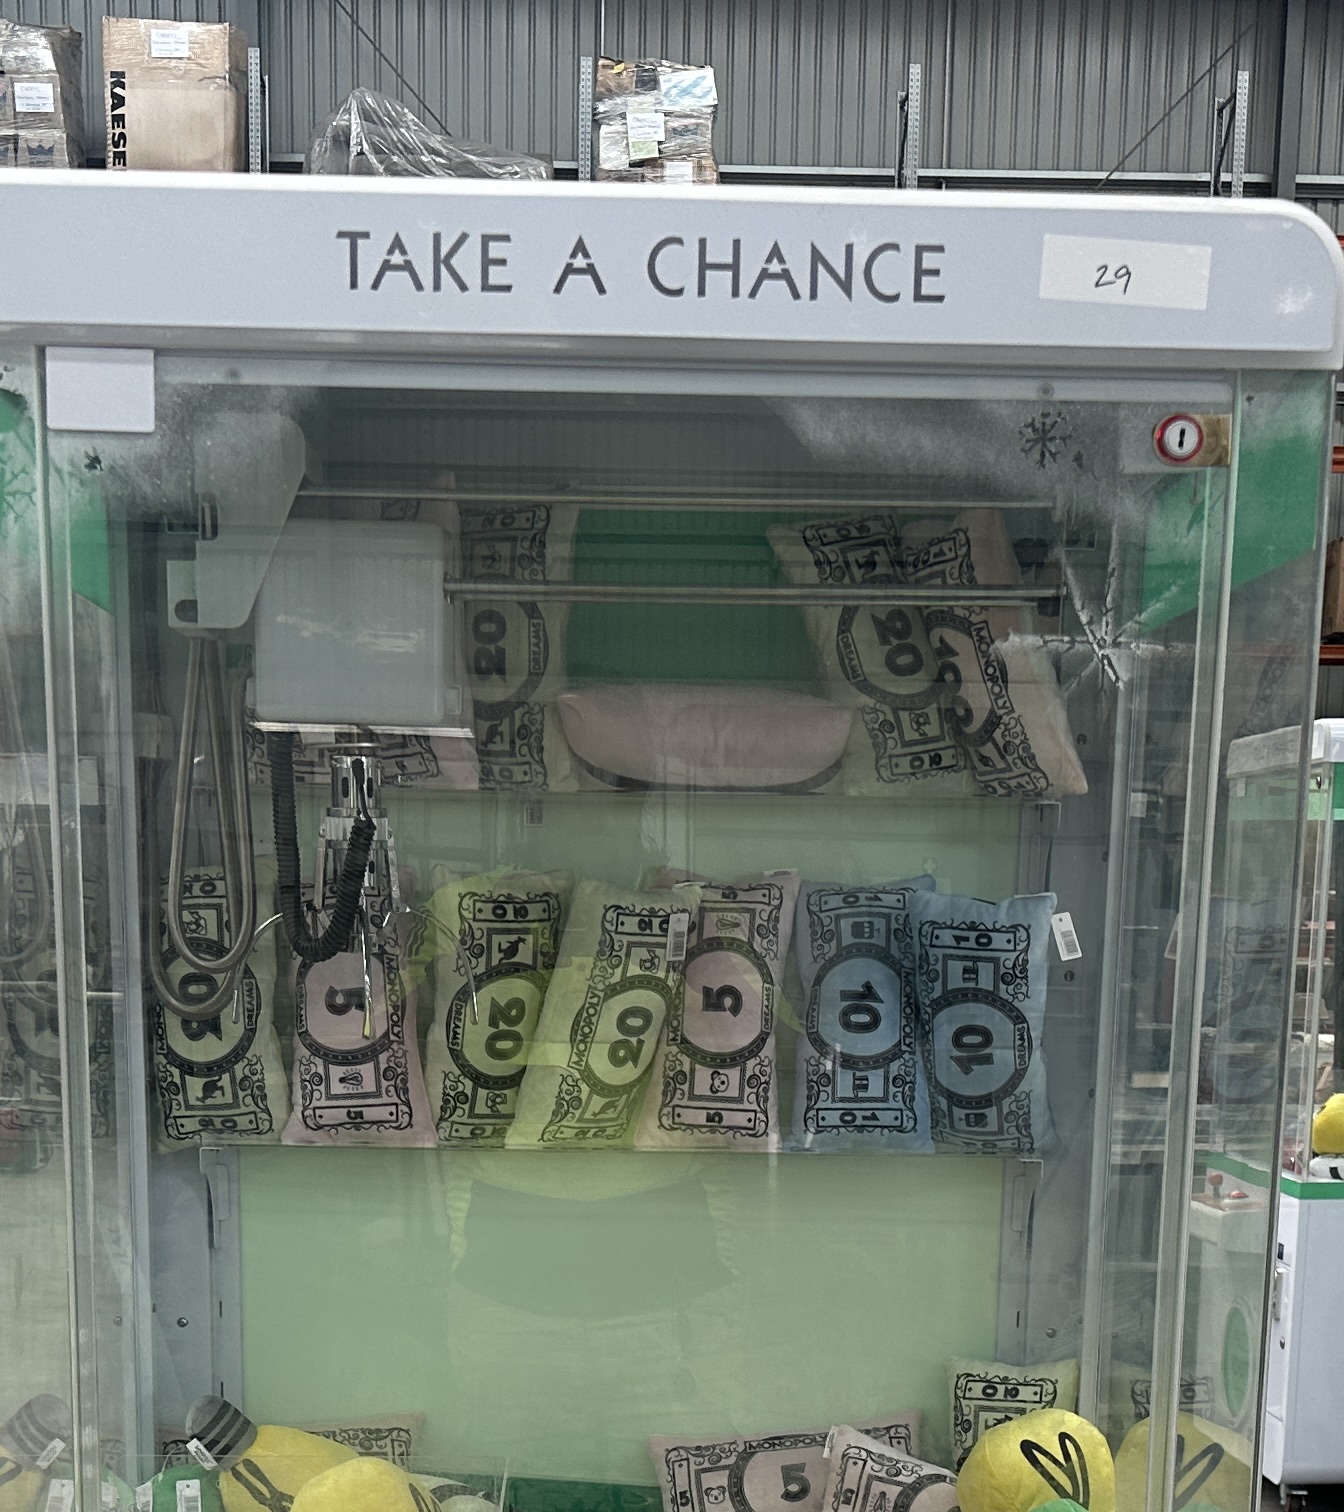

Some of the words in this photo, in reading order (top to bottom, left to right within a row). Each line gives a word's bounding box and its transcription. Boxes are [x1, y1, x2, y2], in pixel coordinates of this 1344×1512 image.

[110, 71, 127, 170] KAESE
[335, 230, 513, 293] TAKE
[552, 236, 607, 296] A
[646, 235, 946, 304] CHANCE
[1093, 263, 1132, 295] 29
[472, 609, 507, 683] 20
[530, 620, 542, 672] DREAMS
[840, 635, 863, 680] DREAMS
[870, 608, 924, 677] 20
[935, 634, 974, 728] 100
[973, 625, 1011, 711] MONOPOLY
[952, 933, 994, 948] 10
[245, 980, 255, 1028] DREAMS
[386, 956, 402, 1040] MONOPOLY
[702, 984, 744, 1018] 5
[762, 986, 773, 1031] DREAMS
[839, 980, 885, 1035] 10
[901, 969, 915, 1050] MONOPOLY
[451, 1003, 464, 1049] DREAMS
[485, 996, 527, 1062] 20
[571, 991, 603, 1069] MONOPOLY
[607, 1005, 654, 1069] 20
[949, 1024, 995, 1076] 10
[1017, 1025, 1029, 1068] DREAMS
[346, 1108, 365, 1121] 5
[706, 1110, 724, 1125] 5
[839, 1111, 881, 1125] 10
[748, 1433, 828, 1451] MONOPOLY
[679, 1490, 690, 1507] 5
[780, 1462, 812, 1502] 5
